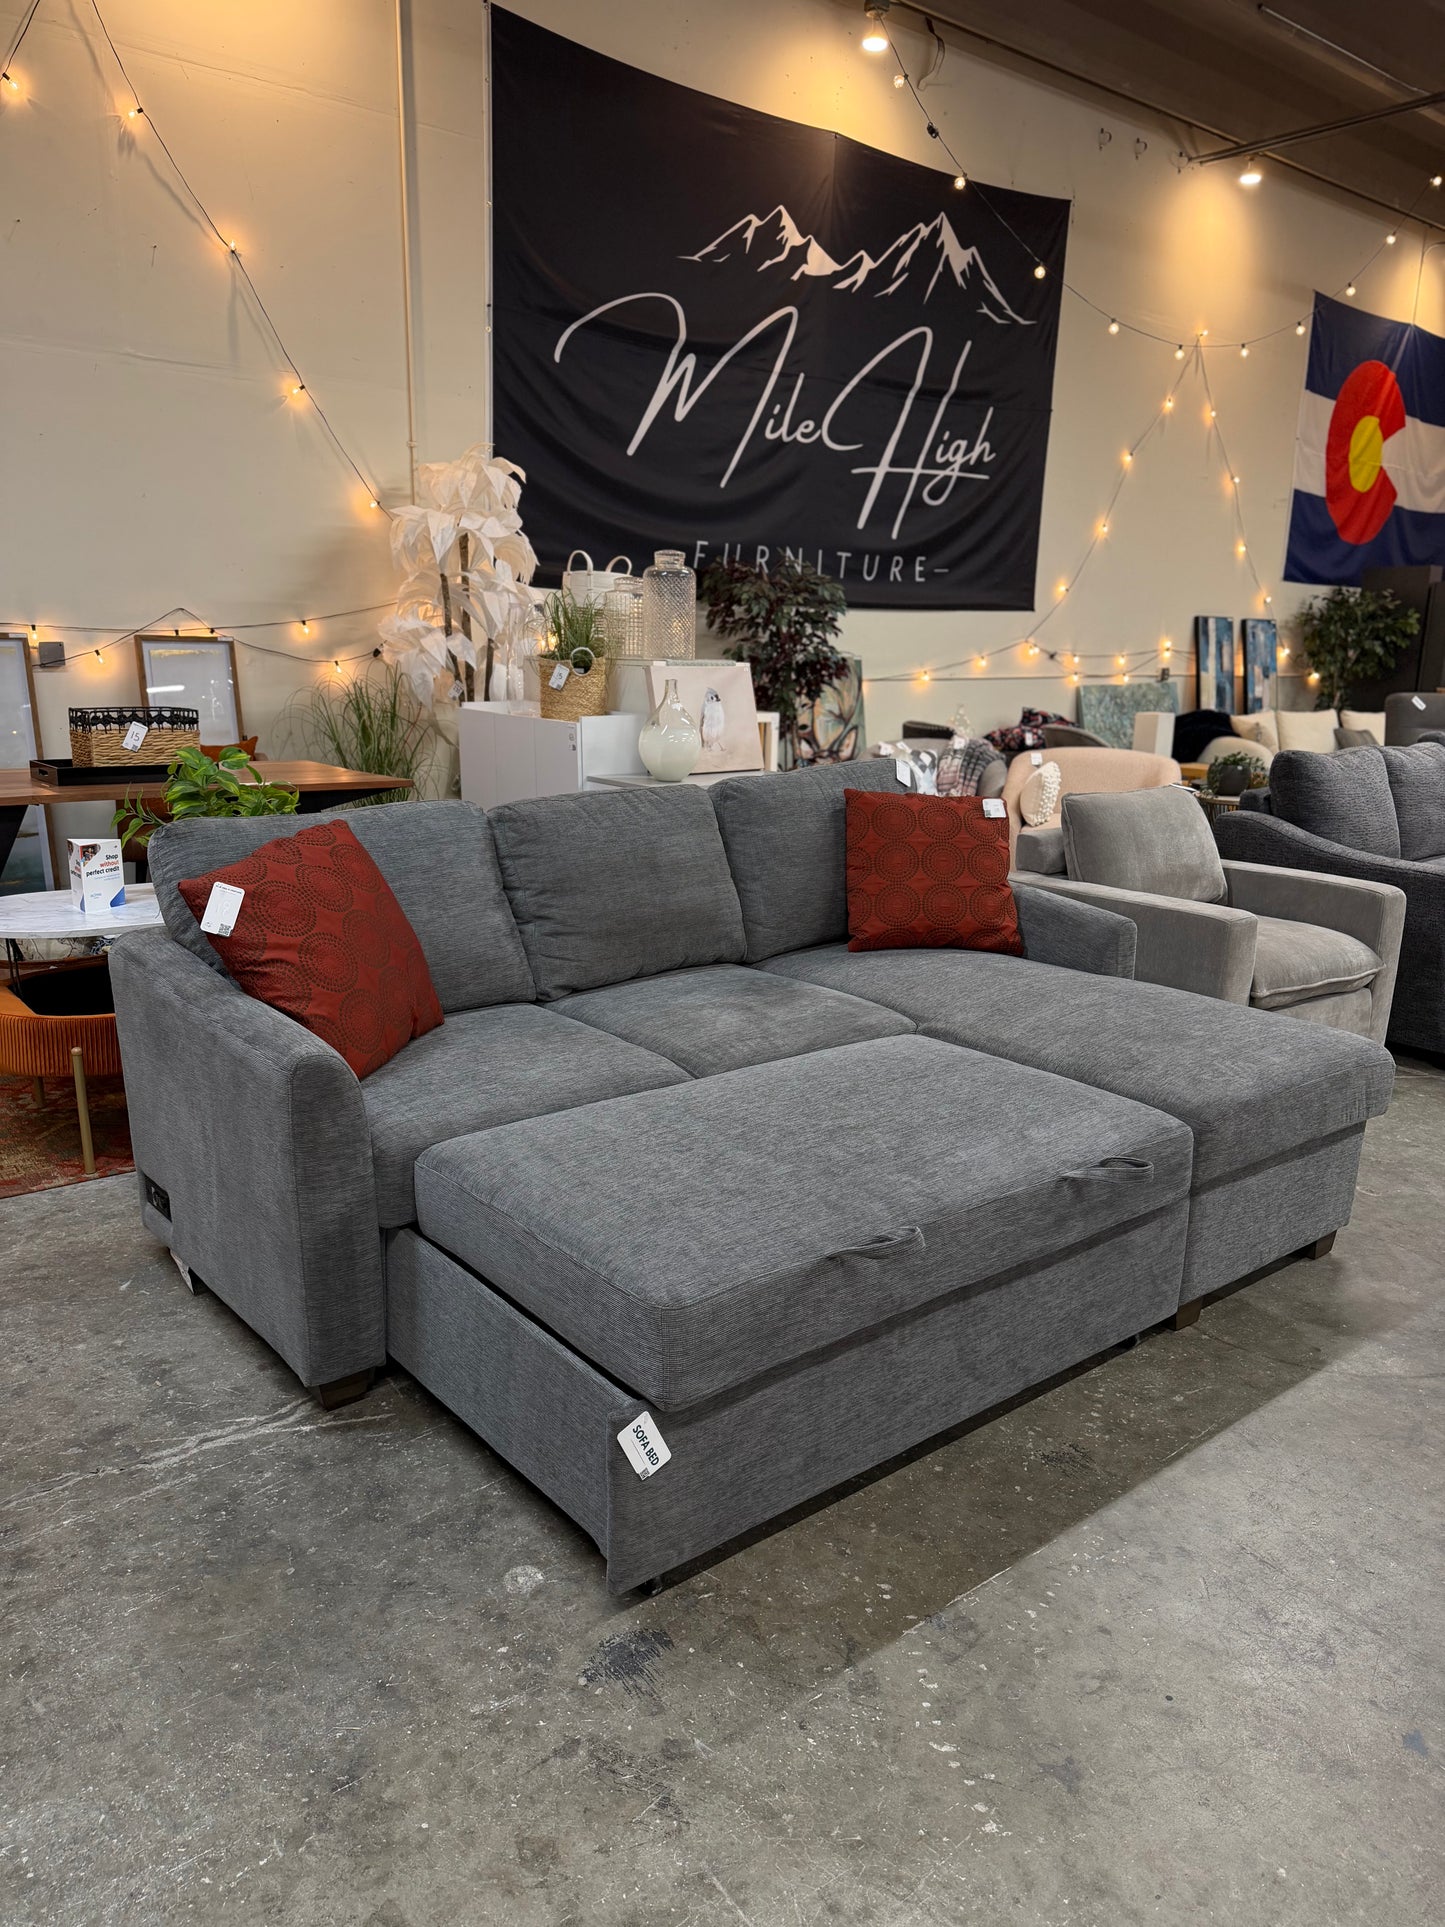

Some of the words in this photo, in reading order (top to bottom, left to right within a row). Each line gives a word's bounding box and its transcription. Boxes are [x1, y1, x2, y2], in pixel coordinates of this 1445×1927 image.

[555, 292, 821, 489] Mile
[821, 325, 997, 541] High
[86, 868, 105, 877] perfect
[99, 860, 120, 868] without
[632, 1424, 651, 1451] SOFA
[645, 1447, 660, 1466] BED
